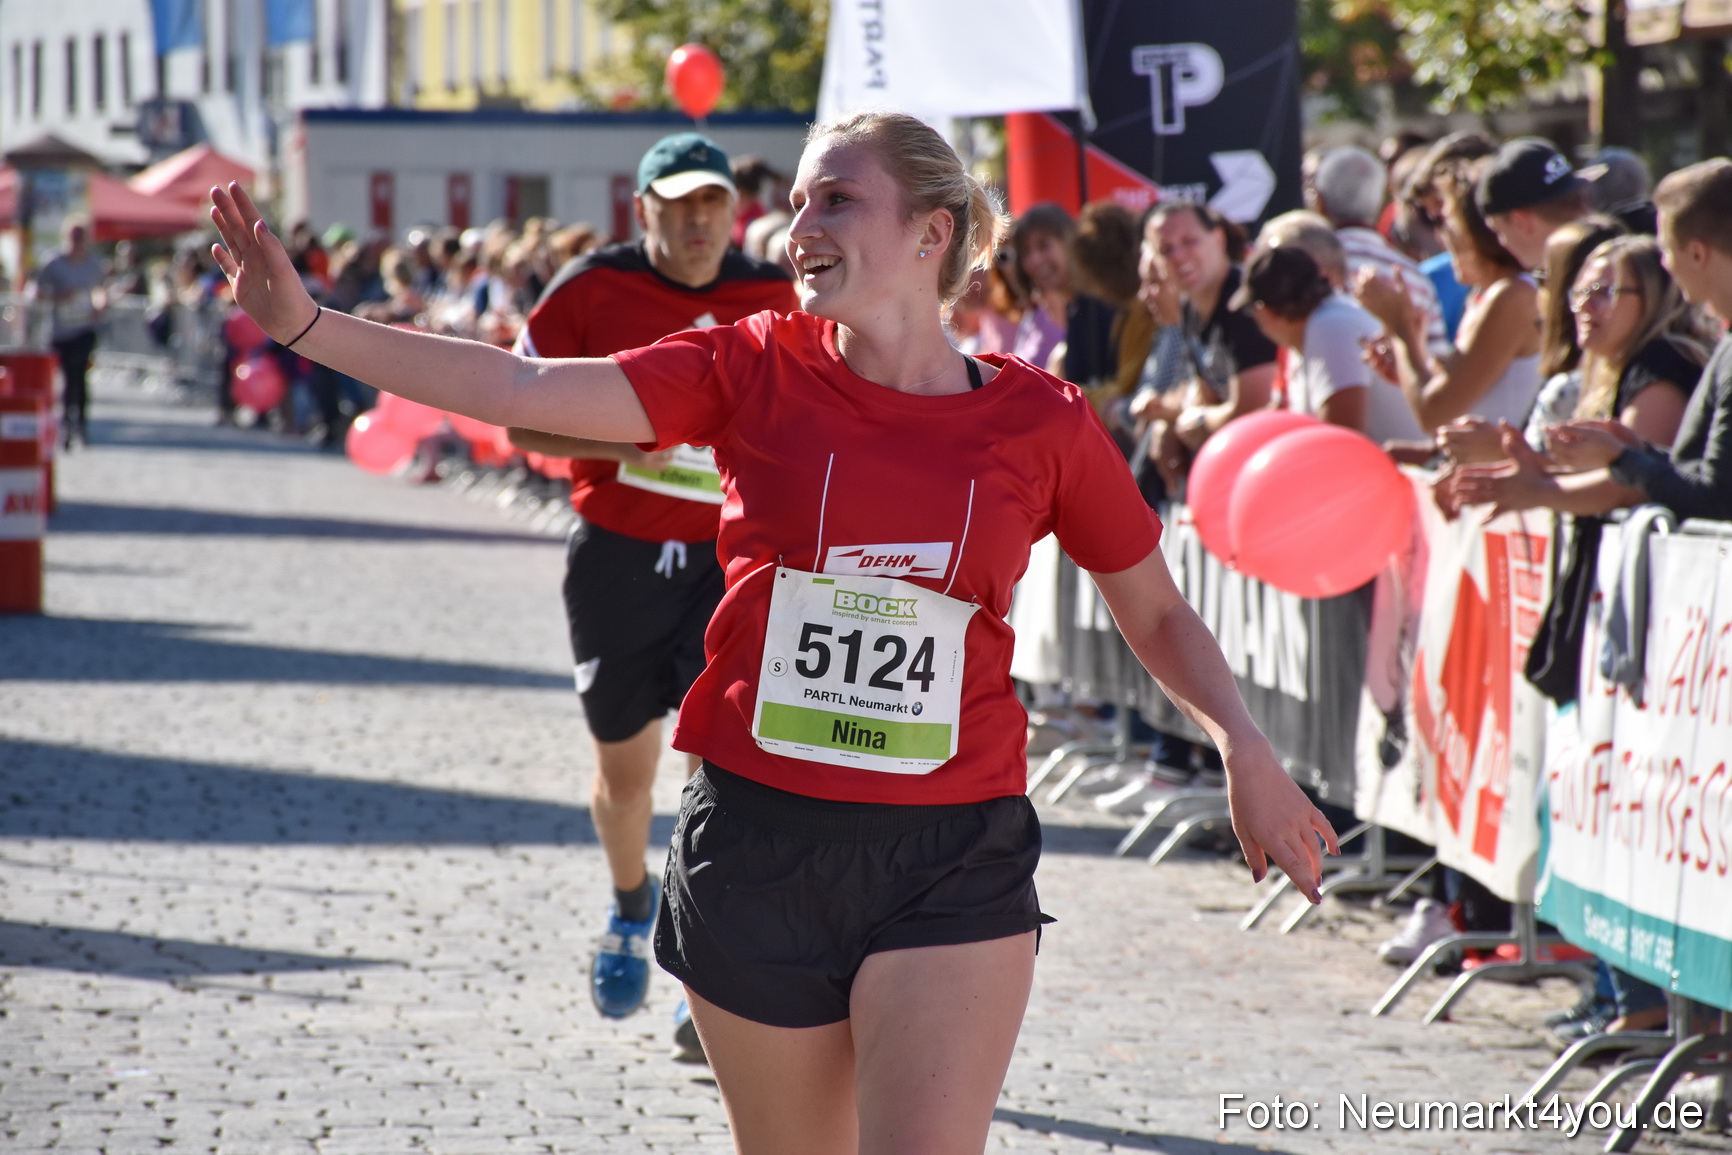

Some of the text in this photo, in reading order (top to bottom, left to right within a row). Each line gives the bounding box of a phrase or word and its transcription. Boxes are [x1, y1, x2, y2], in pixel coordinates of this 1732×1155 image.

[858, 554, 917, 569] DEHN
[833, 589, 918, 618] BOCK
[832, 609, 919, 627] inspired by smart concepts
[773, 661, 782, 673] S
[795, 622, 936, 693] 5124
[803, 688, 908, 714] PARTL Neumarkt
[831, 719, 887, 750] Nina
